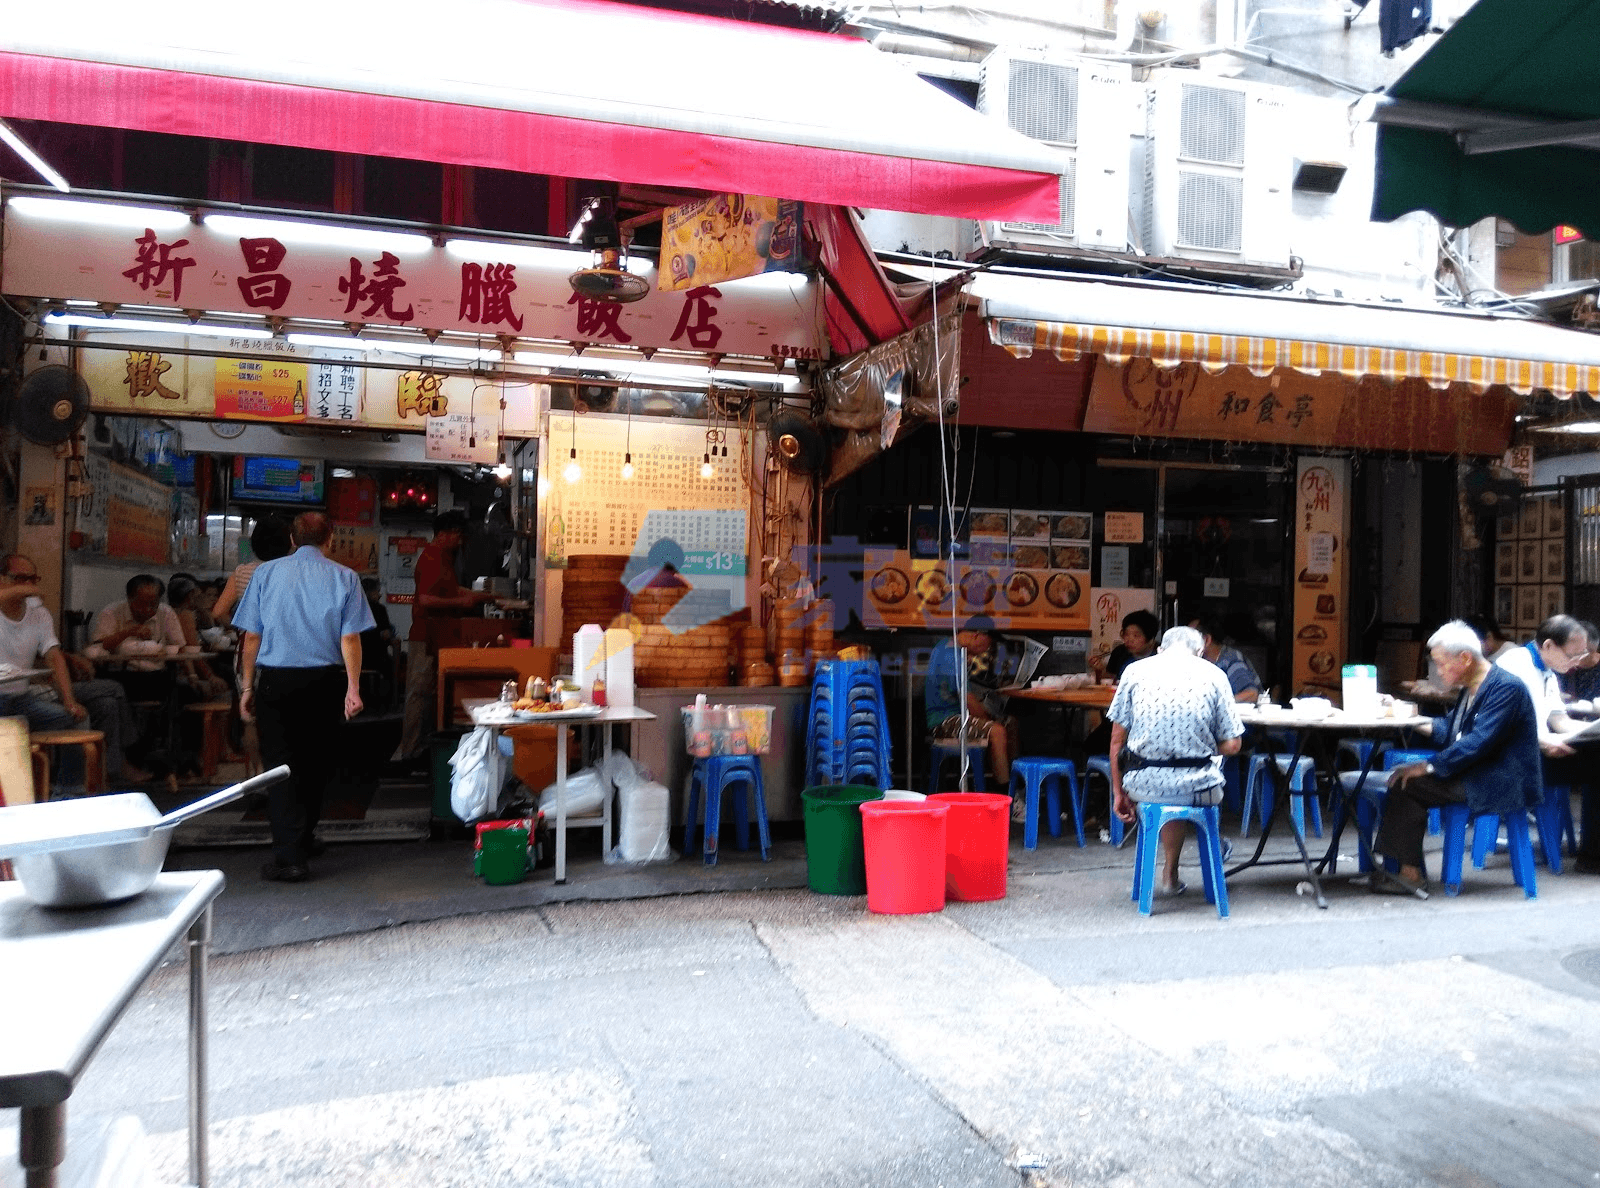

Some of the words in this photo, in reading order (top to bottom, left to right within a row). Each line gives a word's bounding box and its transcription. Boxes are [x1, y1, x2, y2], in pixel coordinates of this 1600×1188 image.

[122, 228, 722, 348] 新昌燒臘飯店
[272, 368, 290, 379] $25
[1217, 390, 1314, 430] 和食亭
[706, 552, 733, 570] $13
